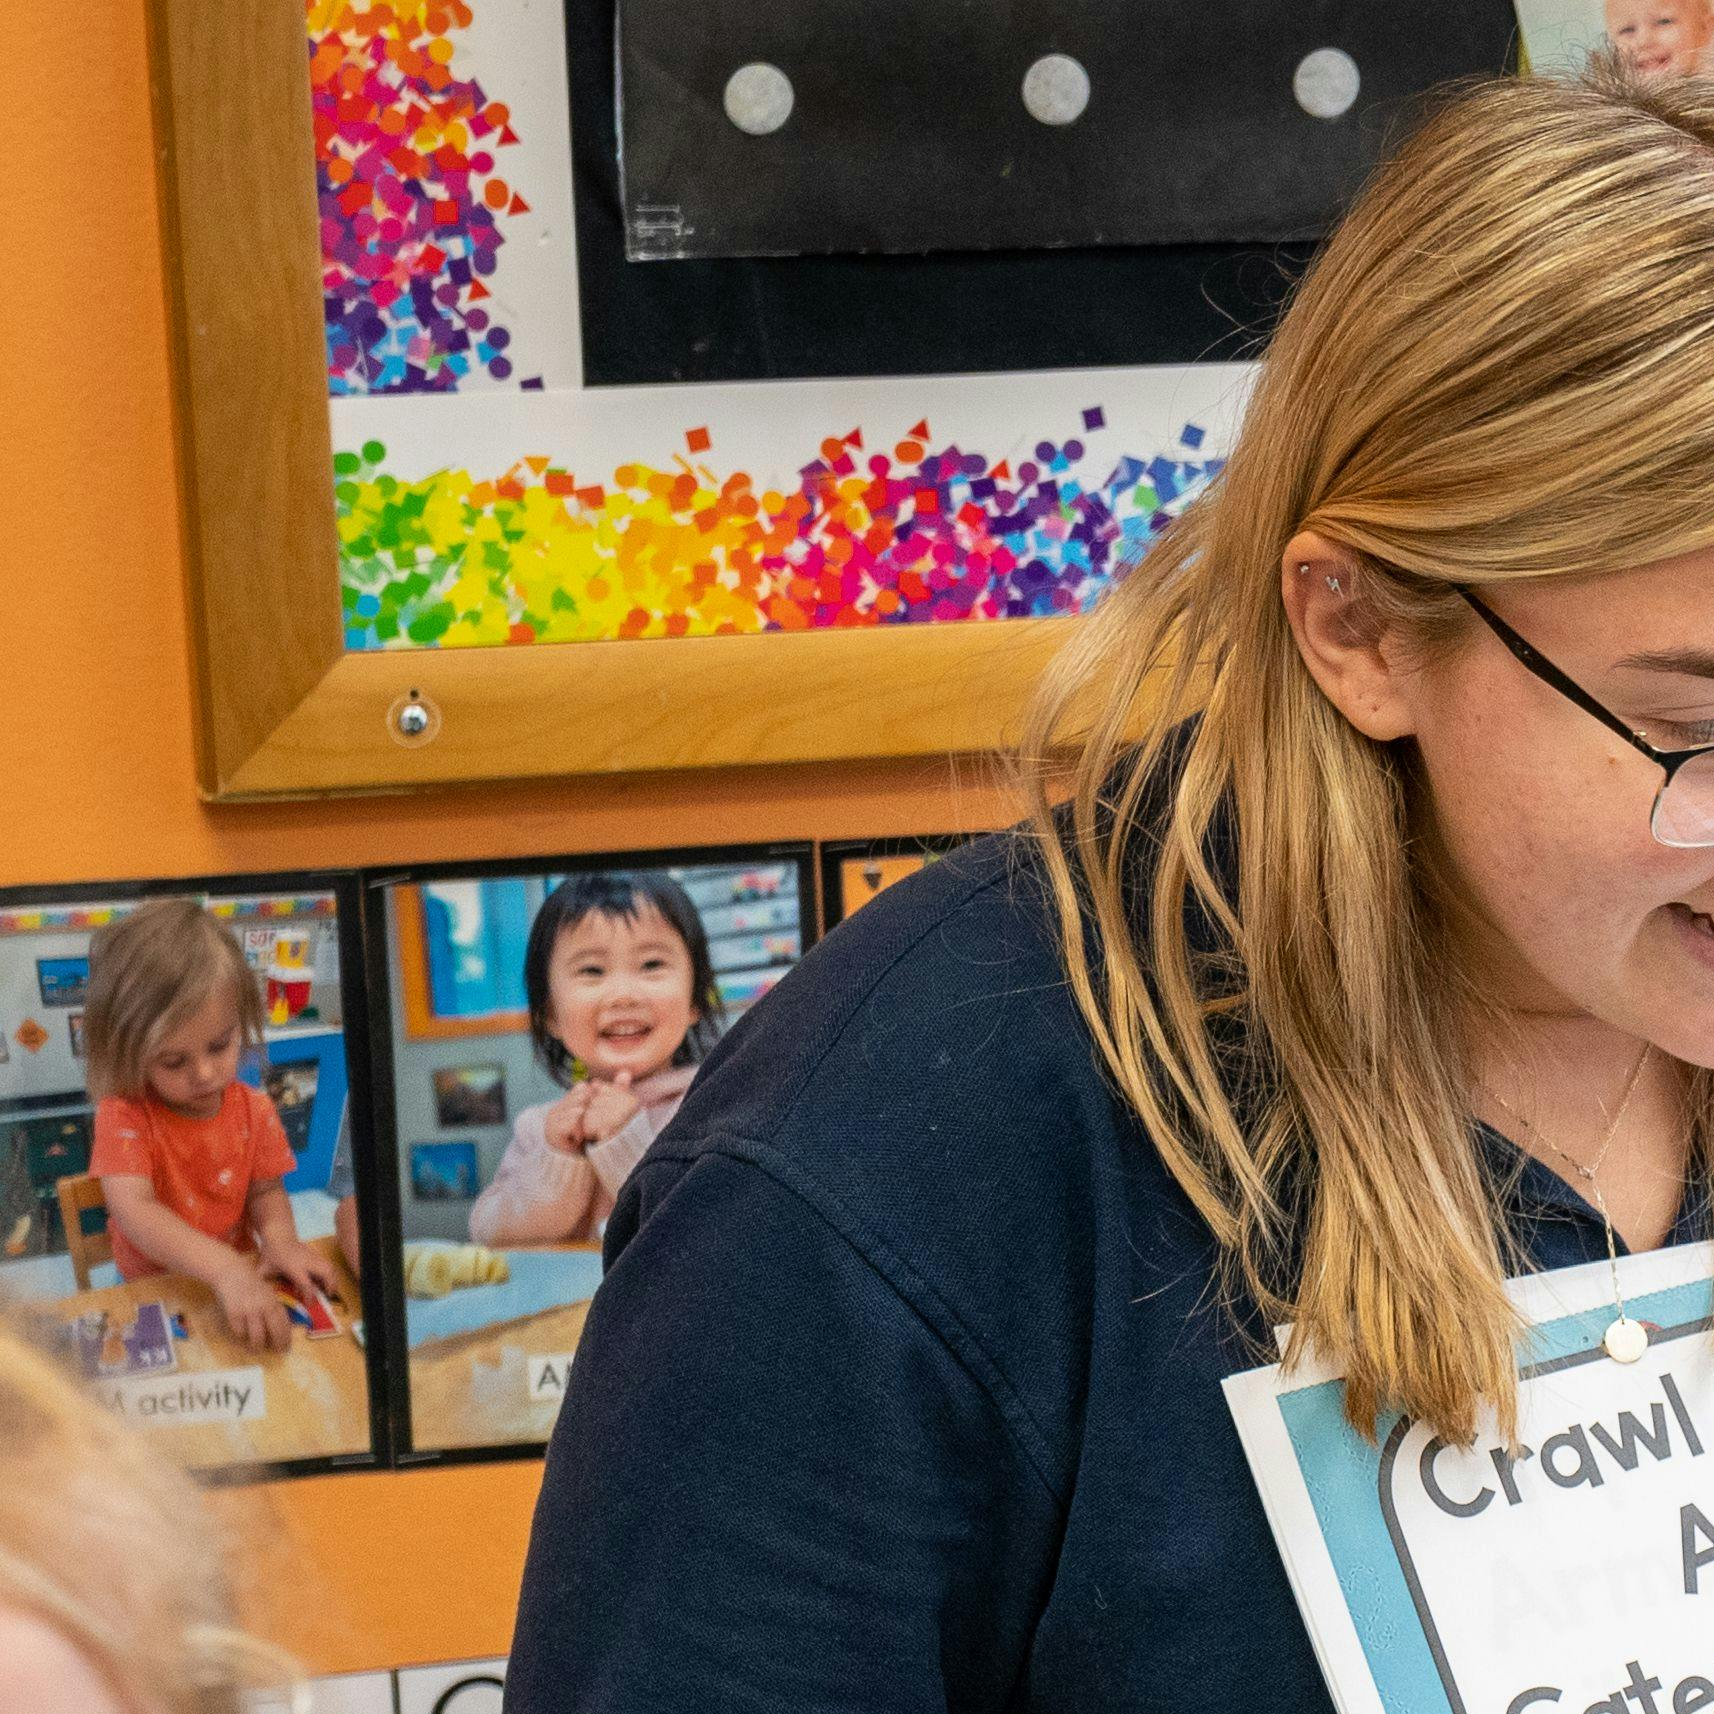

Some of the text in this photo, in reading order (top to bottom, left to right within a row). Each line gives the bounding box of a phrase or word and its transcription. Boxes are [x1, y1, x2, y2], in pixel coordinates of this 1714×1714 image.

[537, 1361, 572, 1393] A
[138, 1380, 252, 1417] activity
[1420, 1372, 1706, 1519] Crawl
